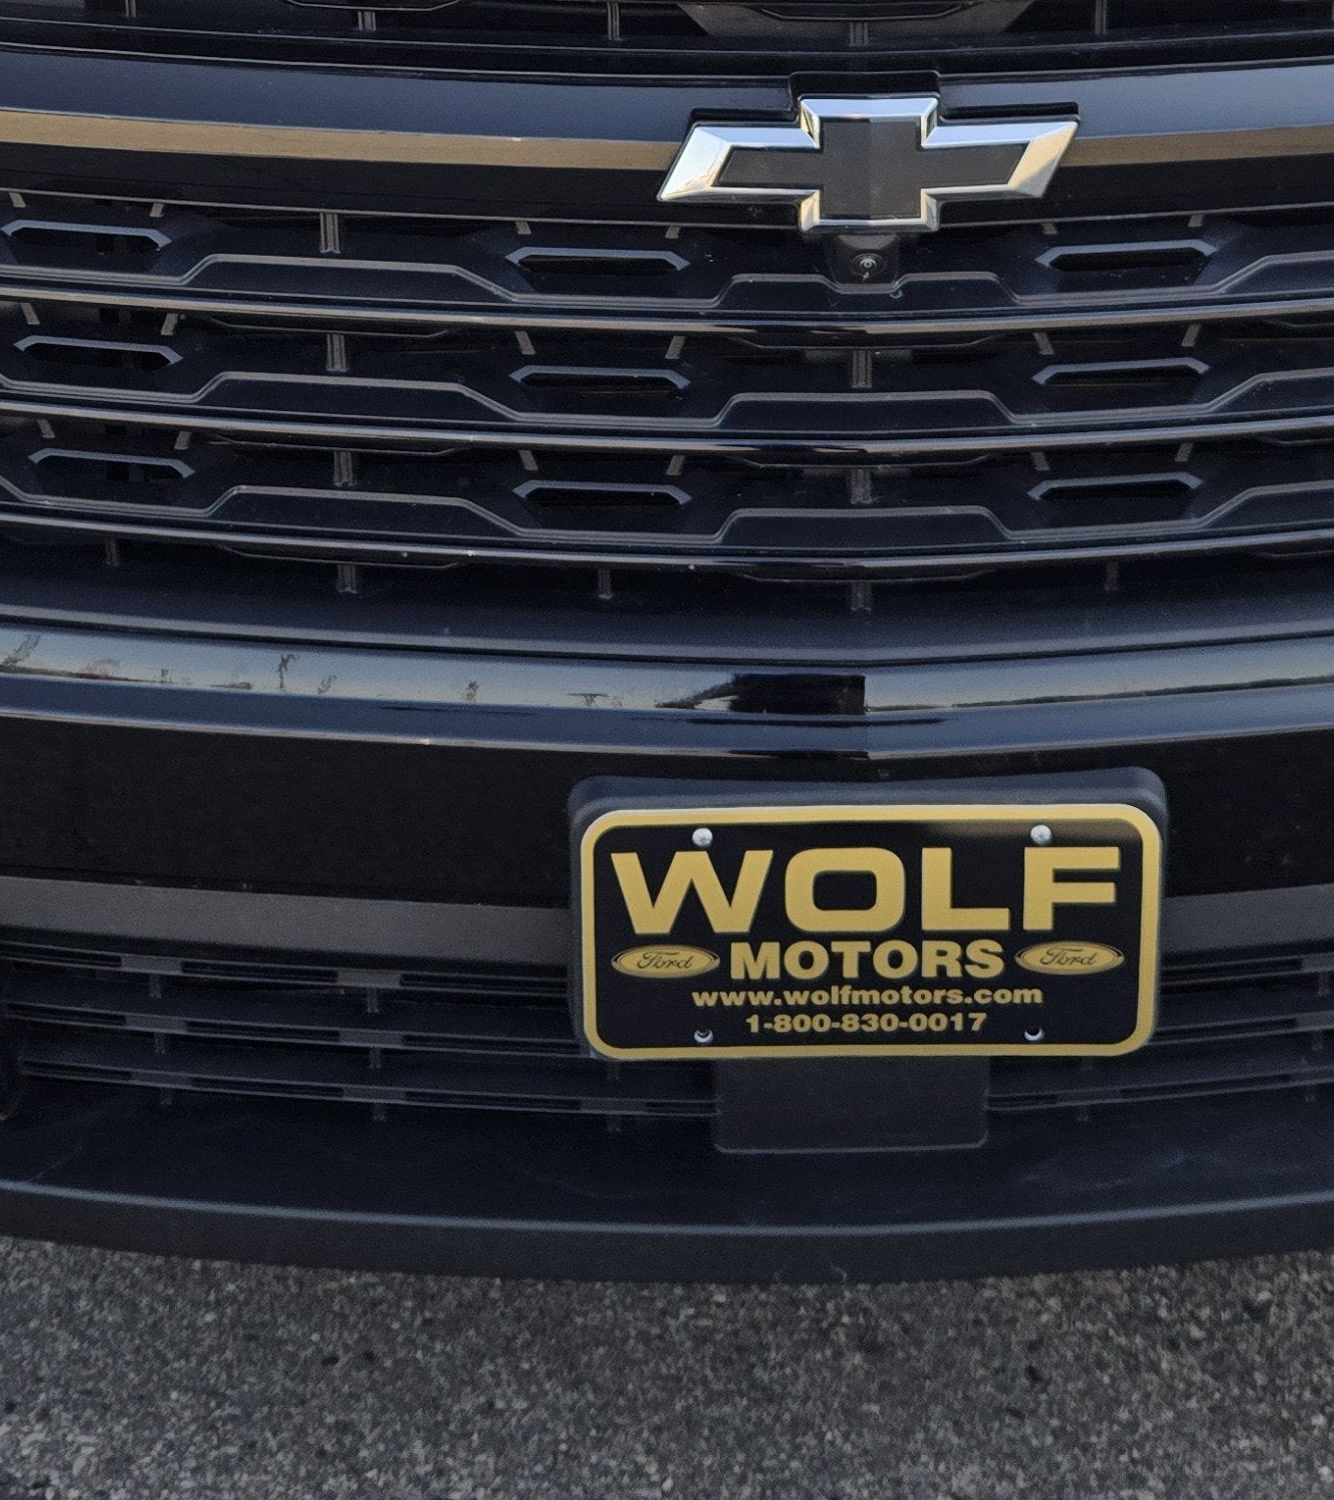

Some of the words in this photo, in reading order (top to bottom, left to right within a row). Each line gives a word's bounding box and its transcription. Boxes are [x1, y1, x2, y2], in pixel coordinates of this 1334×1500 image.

[610, 846, 1120, 934] WOLF
[636, 951, 694, 969] Ford
[730, 940, 1005, 981] MOTORS
[1039, 947, 1098, 966] Ford
[692, 985, 1043, 1007] www.wolfmotors.com
[745, 1012, 987, 1034] 1-800-830-0017
